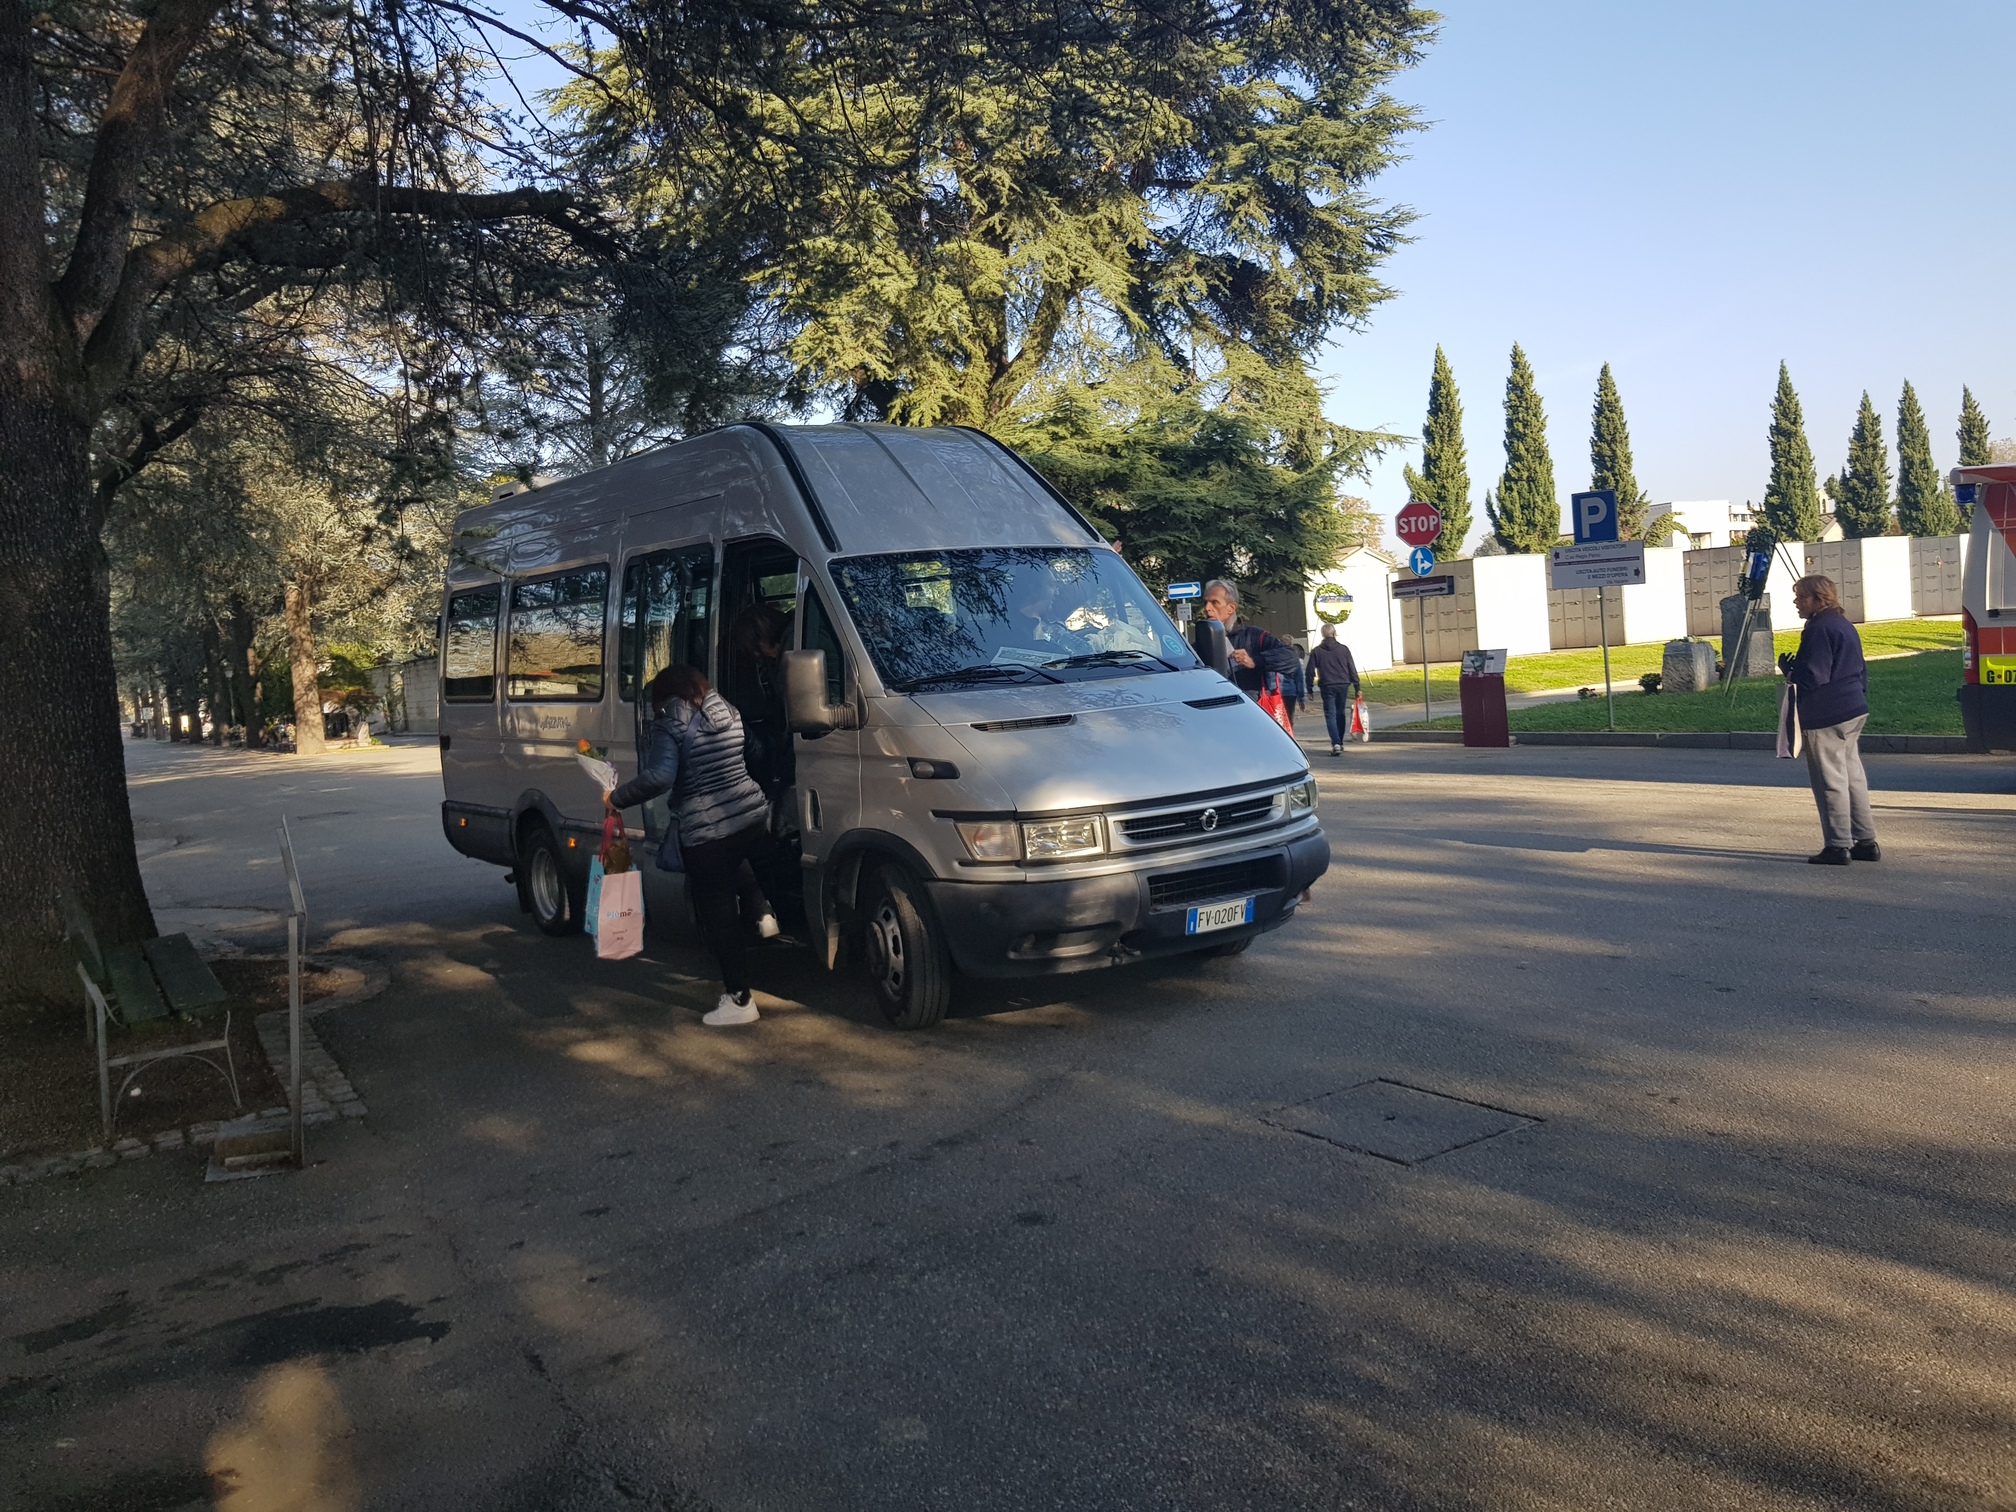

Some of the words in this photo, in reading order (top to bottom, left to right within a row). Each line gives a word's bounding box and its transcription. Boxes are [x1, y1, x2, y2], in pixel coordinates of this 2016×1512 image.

[1399, 514, 1439, 534] STOP
[1580, 496, 1607, 539] P
[1986, 670, 1995, 683] G
